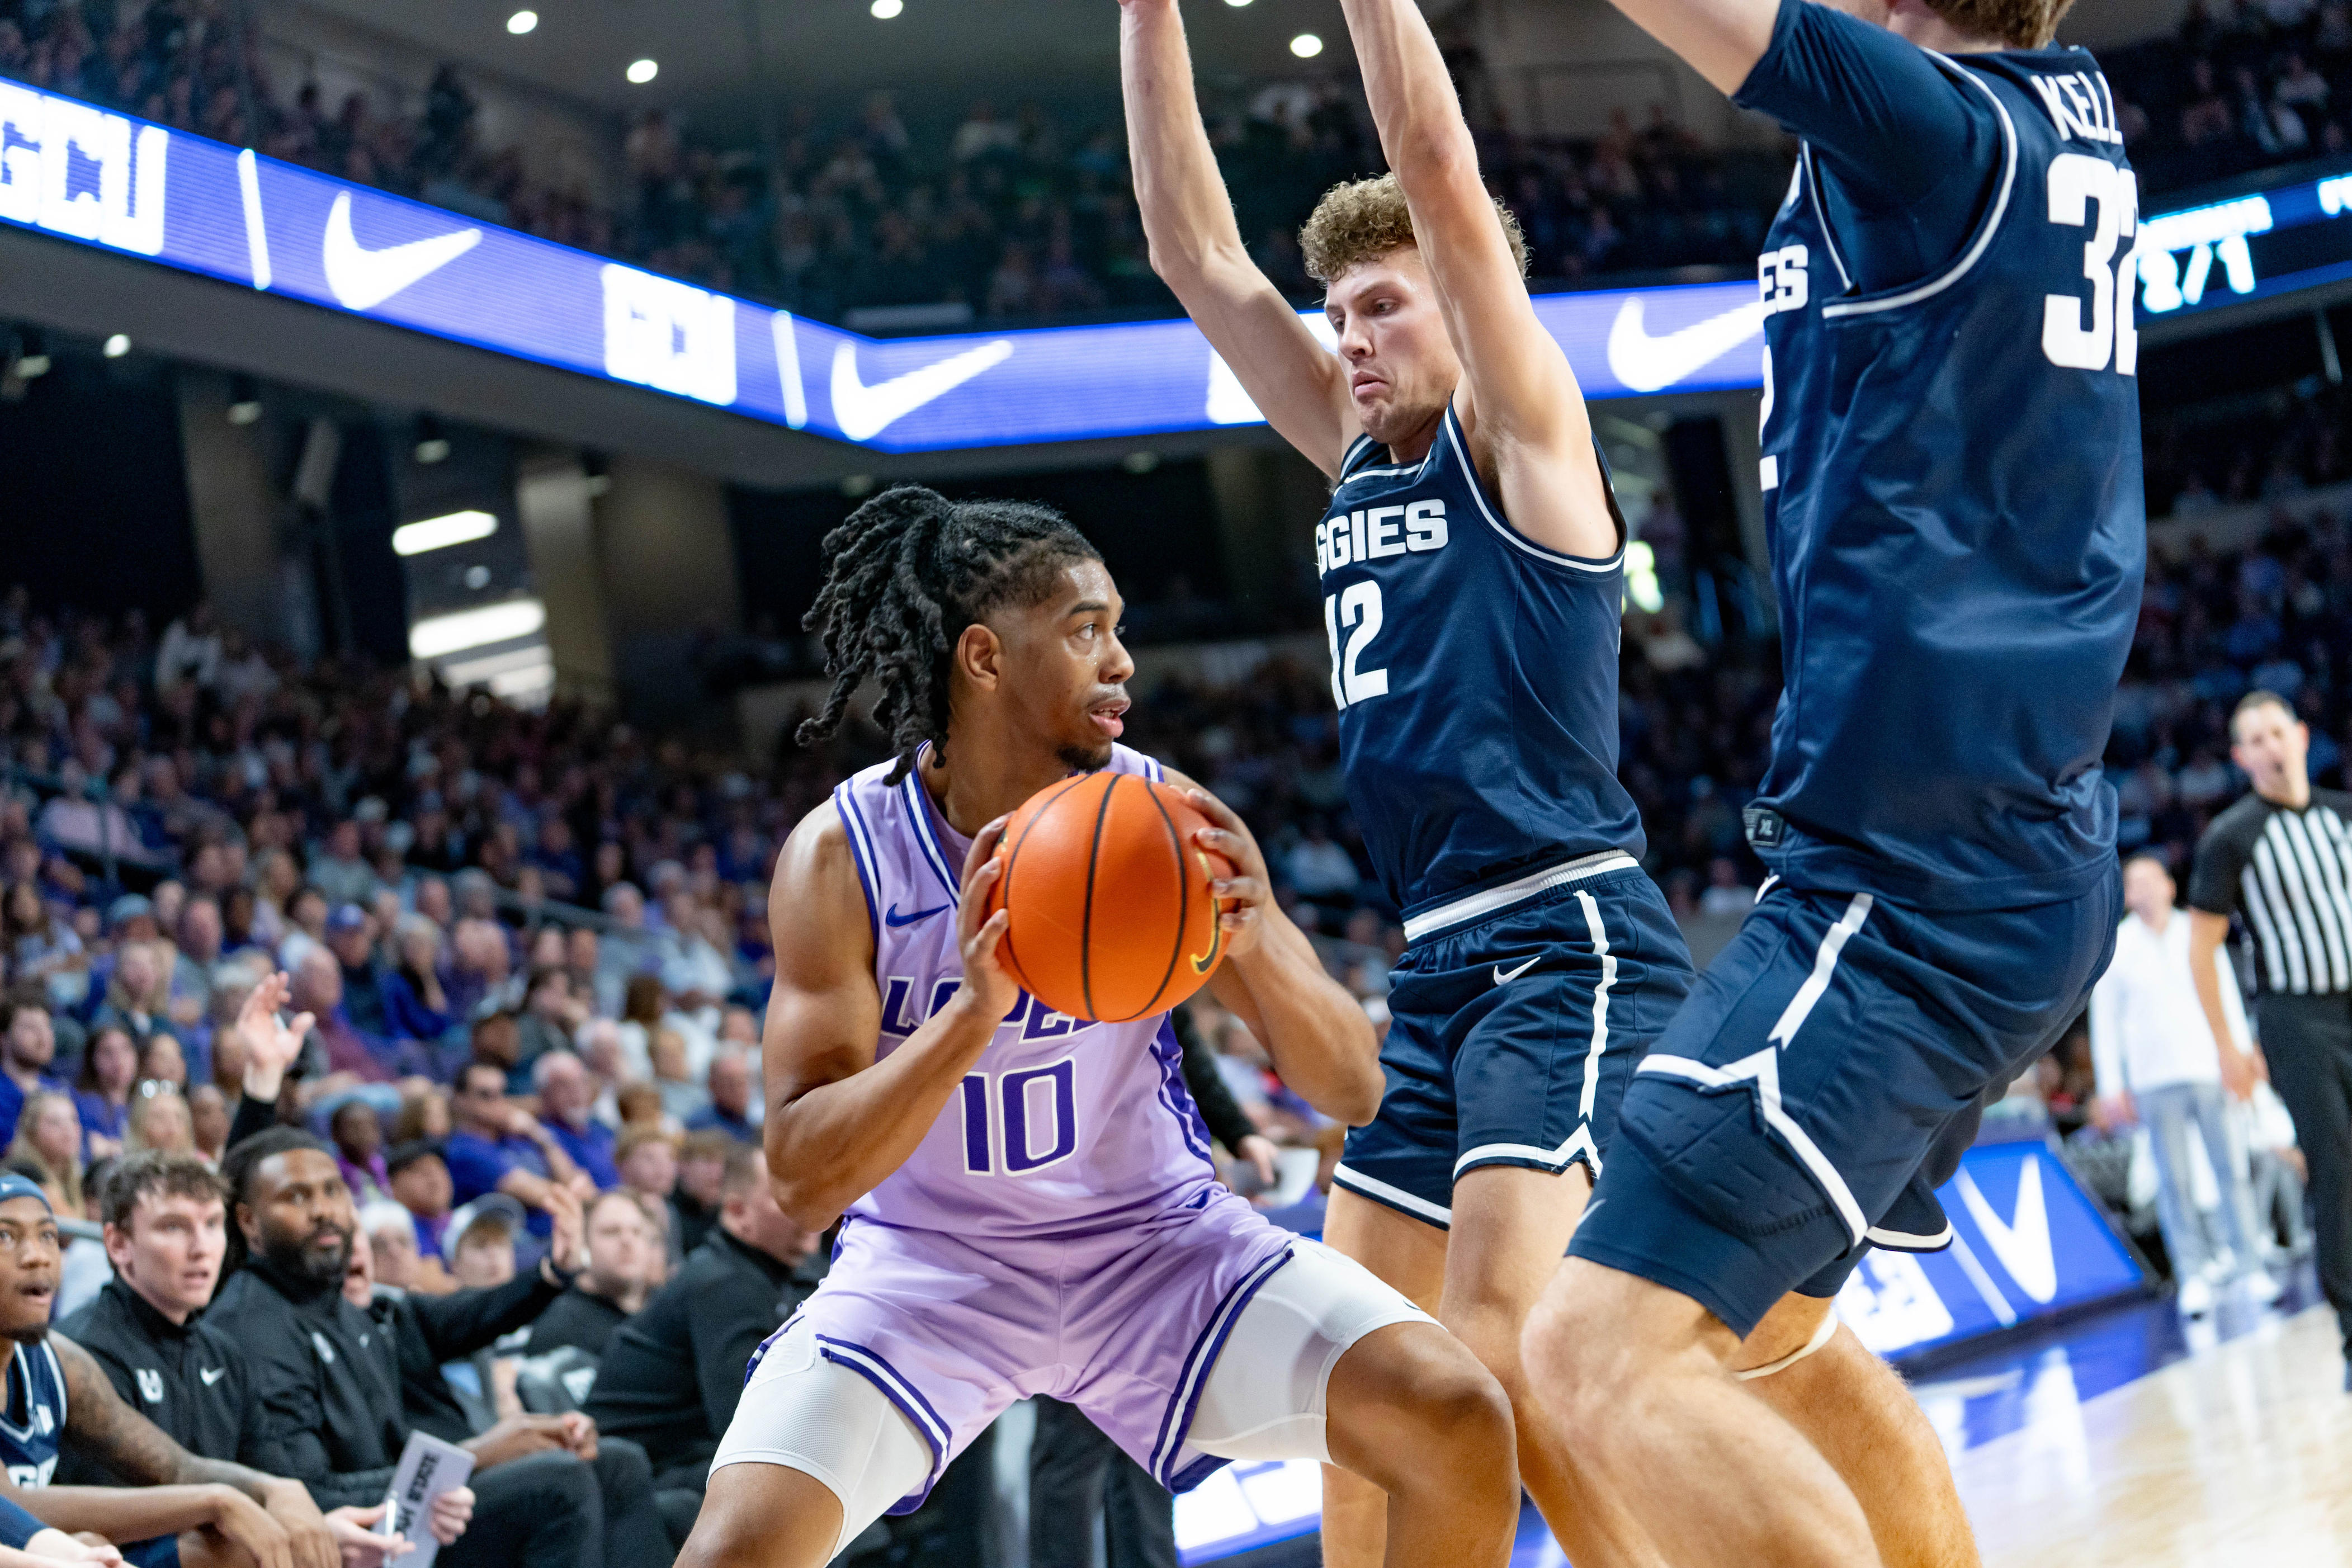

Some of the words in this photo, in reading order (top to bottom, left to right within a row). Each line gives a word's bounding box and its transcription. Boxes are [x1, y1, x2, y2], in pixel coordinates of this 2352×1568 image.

[0, 82, 169, 256] GCU
[1325, 580, 1388, 711] 12
[958, 1055, 1079, 1177] 10
